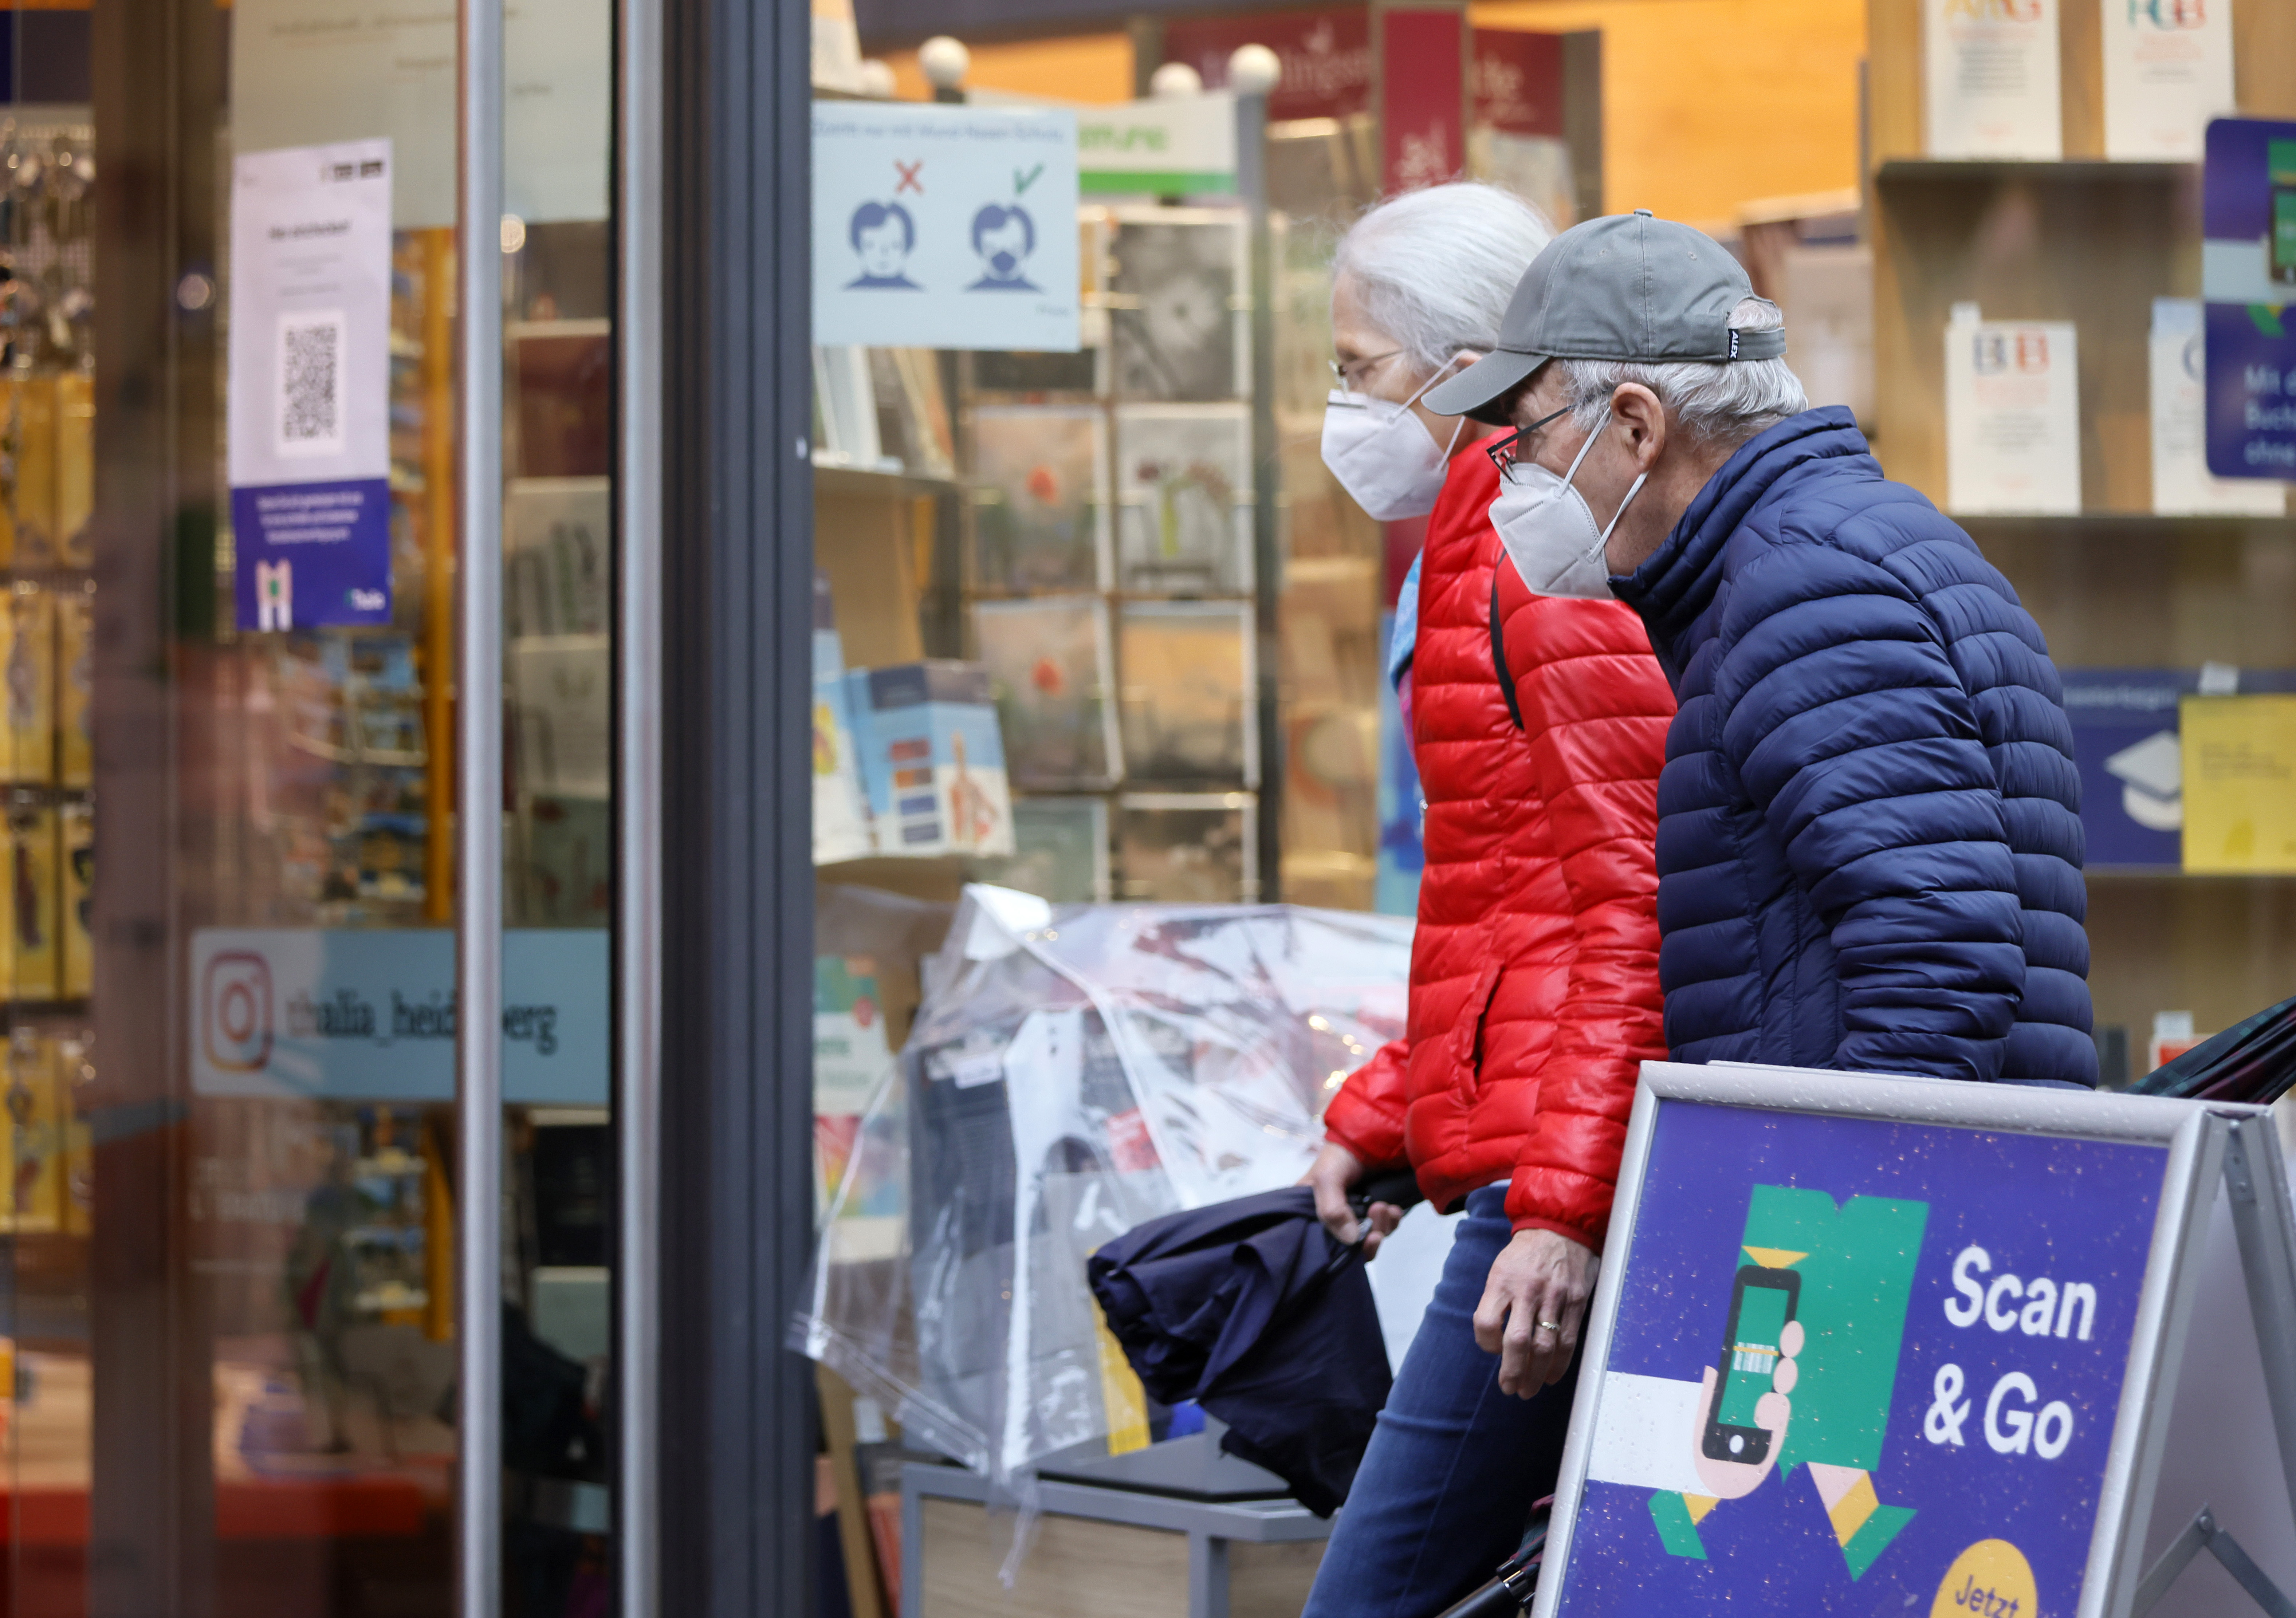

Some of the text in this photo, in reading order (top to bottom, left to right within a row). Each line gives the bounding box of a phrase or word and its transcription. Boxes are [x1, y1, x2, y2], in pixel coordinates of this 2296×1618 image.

[1730, 330, 1739, 359] ALEX
[1944, 1245, 2097, 1341] Scan
[1923, 1363, 2073, 1460] & Go
[1955, 1574, 2020, 1618] Jetzt
